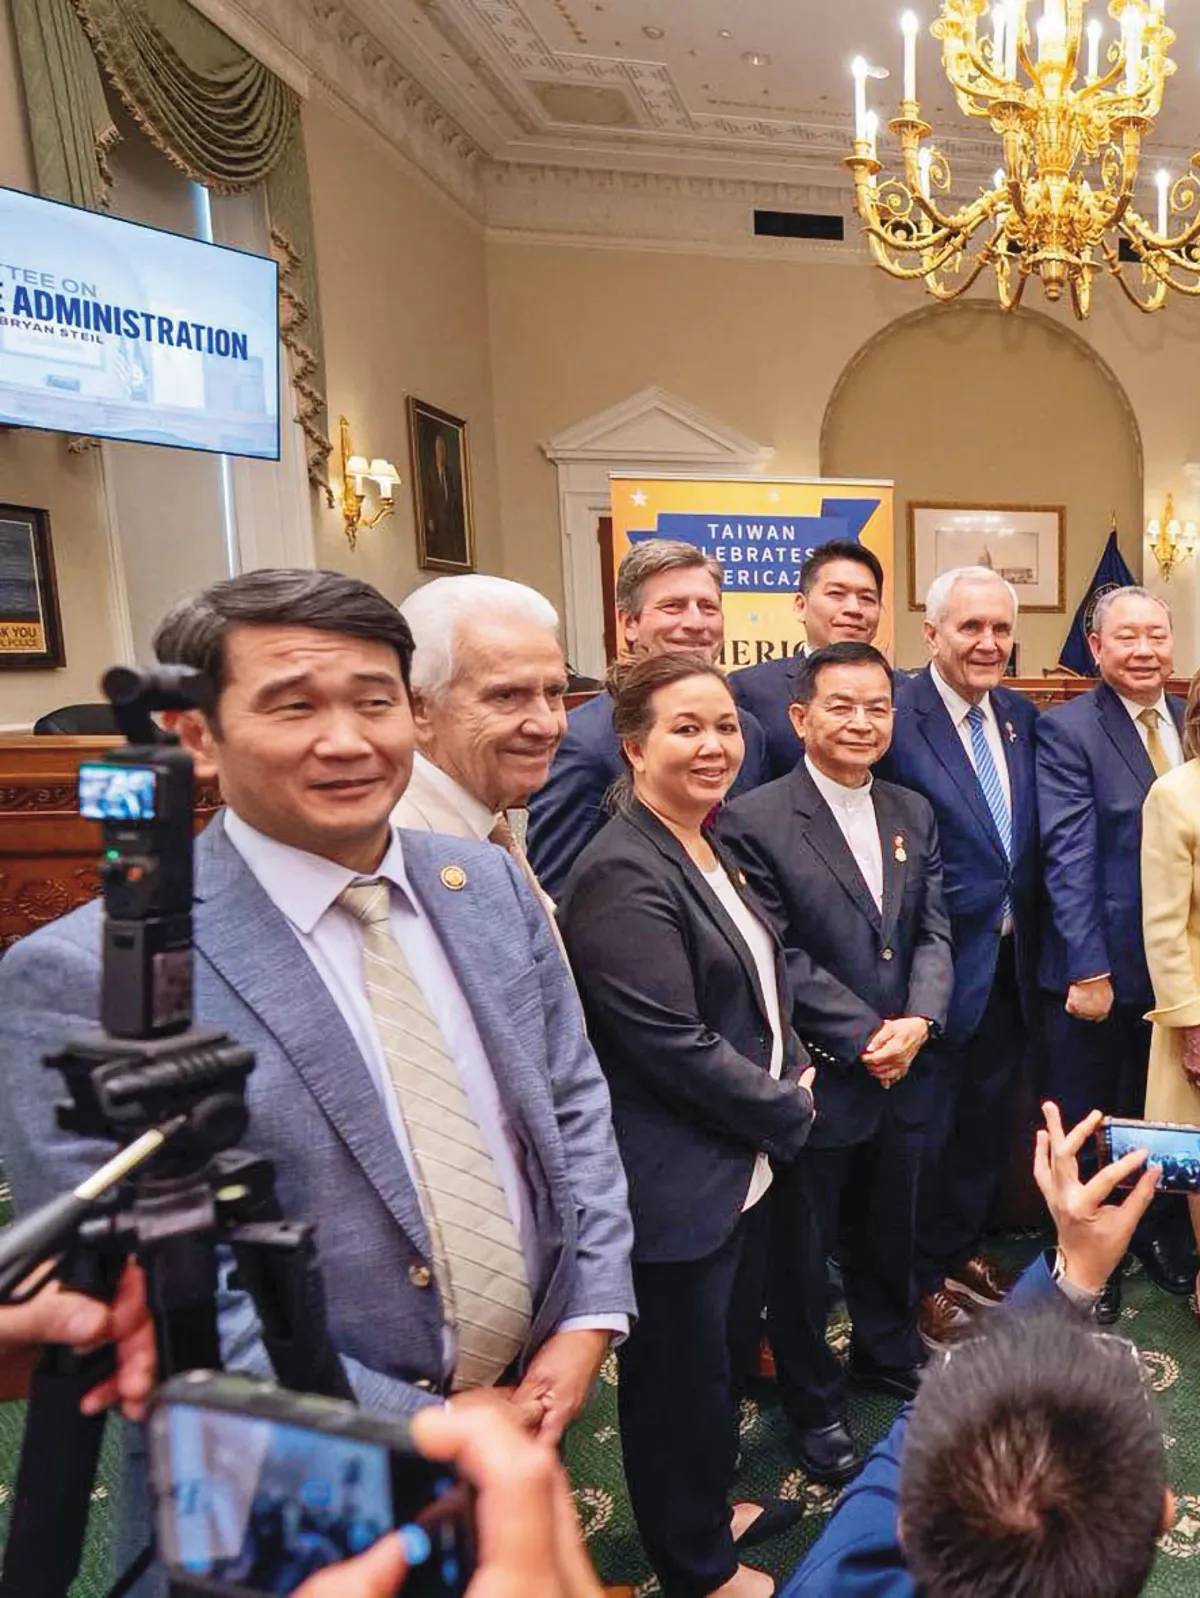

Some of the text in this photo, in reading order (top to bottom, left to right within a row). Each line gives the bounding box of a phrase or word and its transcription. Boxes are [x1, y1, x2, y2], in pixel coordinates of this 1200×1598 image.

[0, 263, 97, 298] TEE ON
[0, 316, 104, 345] BRYAN STEIL
[13, 285, 248, 360] ADMINISTRATION
[707, 523, 795, 540] TAIWAN
[723, 569, 801, 586] ERICA2
[12, 627, 37, 637] YOU
